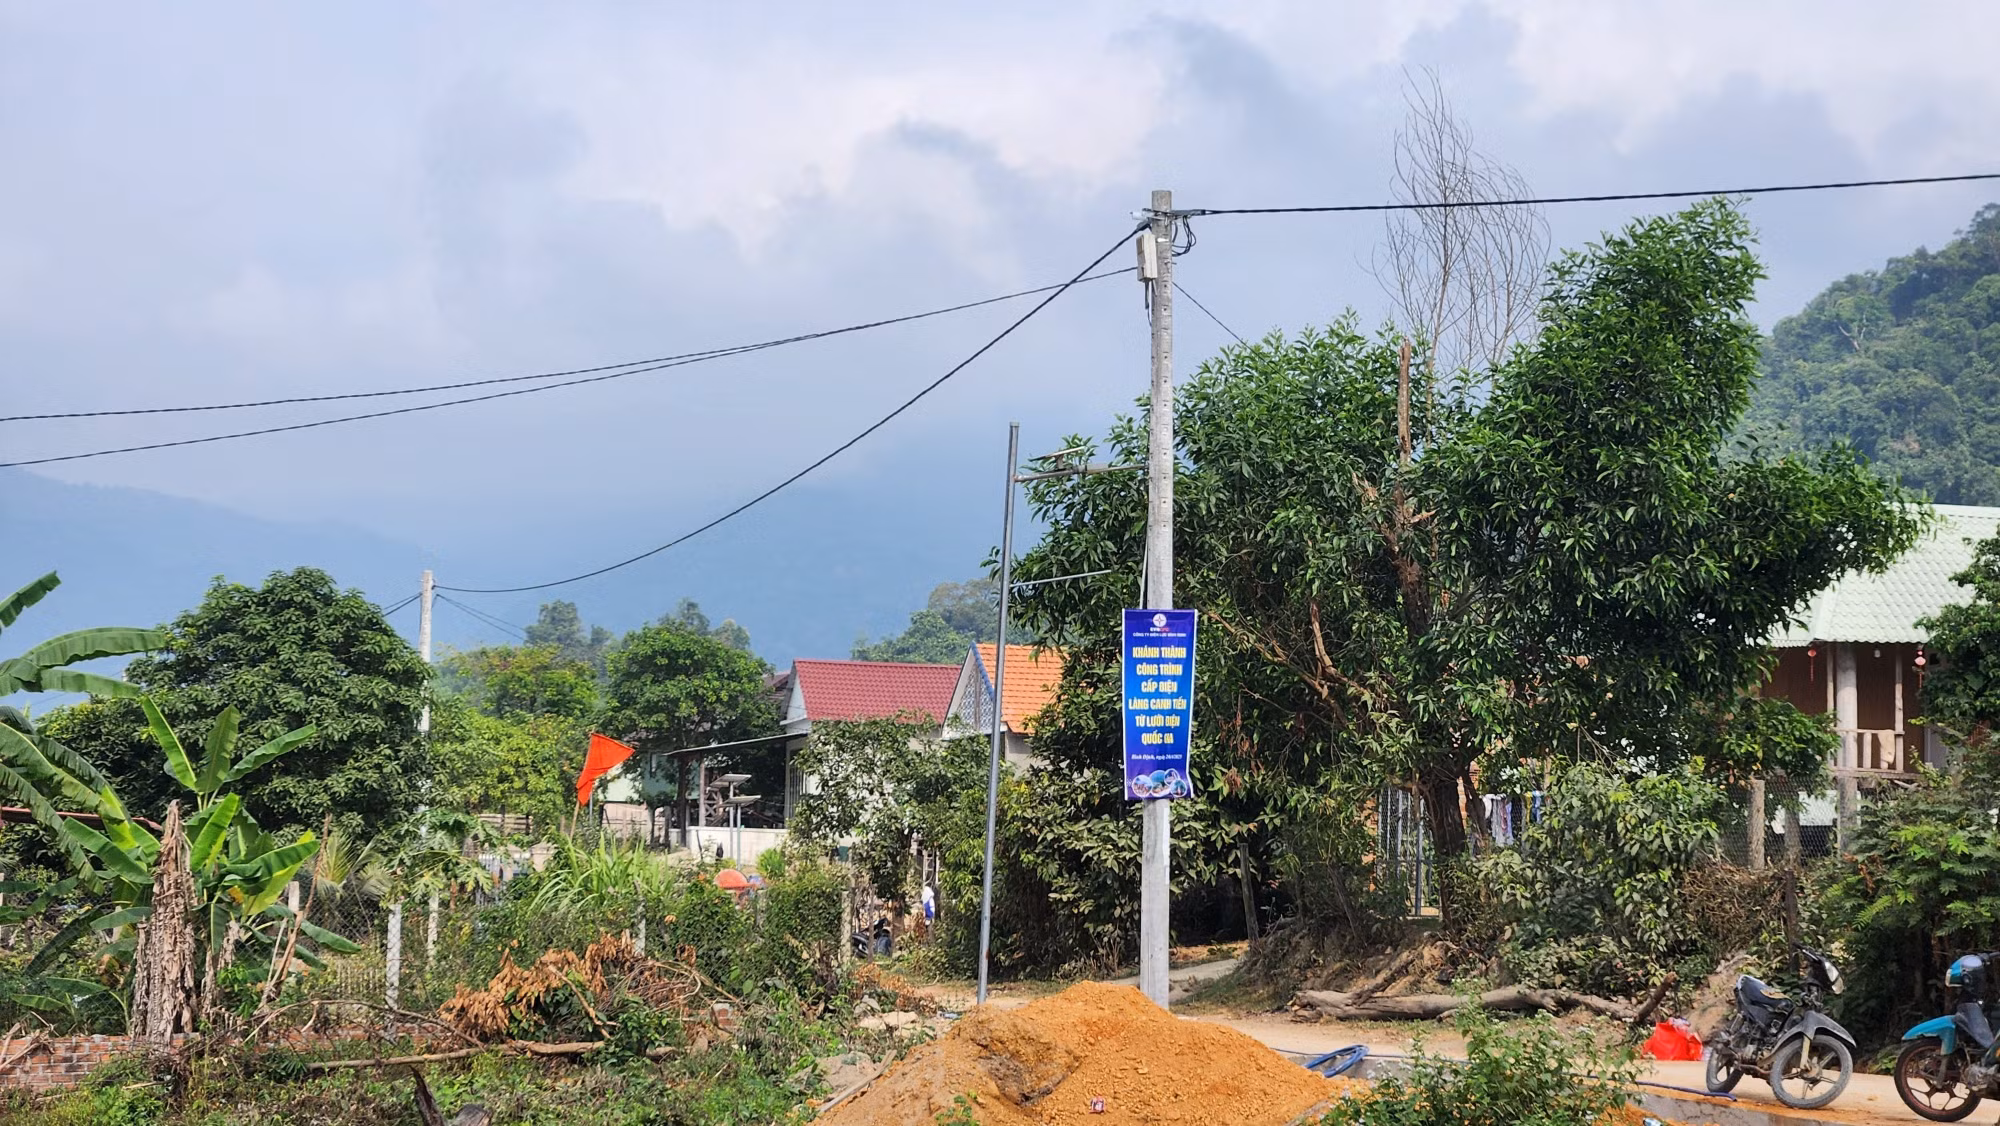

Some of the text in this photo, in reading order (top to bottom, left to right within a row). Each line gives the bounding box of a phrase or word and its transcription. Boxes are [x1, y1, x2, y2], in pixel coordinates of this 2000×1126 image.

[1132, 645, 1186, 658] KHÁNH THÀNH
[1136, 662, 1182, 675] CÔNG TRÌNH
[1141, 678, 1178, 694] CẤP ĐIỆN
[1128, 696, 1186, 710] LÀNG CANH TIẾN
[1135, 714, 1146, 727] TỪ
[1166, 714, 1180, 728] ĐIỆN
[1142, 730, 1162, 745] QUỐC
